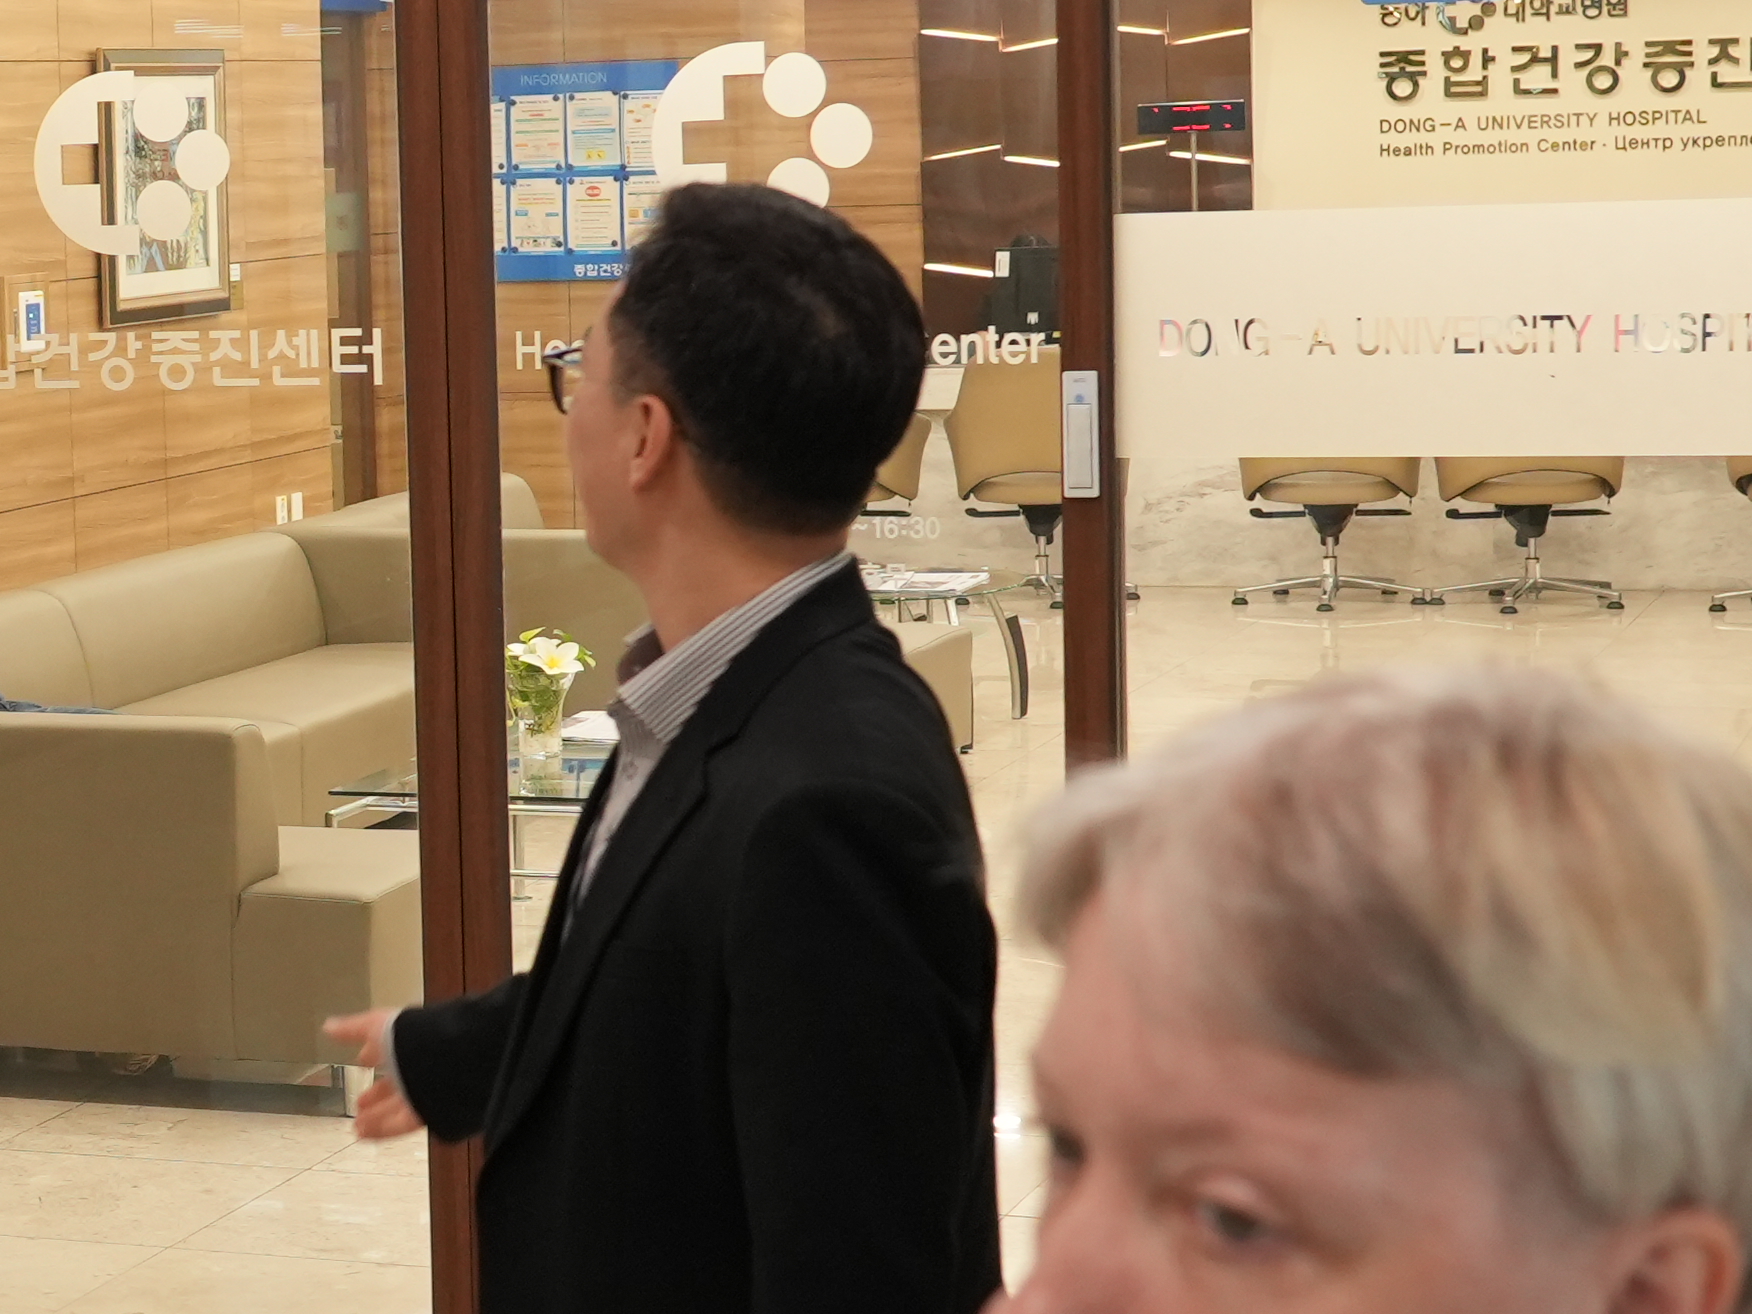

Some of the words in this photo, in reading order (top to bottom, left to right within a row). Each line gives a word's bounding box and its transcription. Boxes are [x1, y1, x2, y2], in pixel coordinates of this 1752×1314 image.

[520, 71, 607, 86] INFORMATION
[1477, 111, 1597, 131] UNIVERSITY
[1608, 109, 1707, 127] HOSPITAL
[1379, 141, 1435, 158] Health
[1442, 139, 1529, 155] Promotion
[1537, 137, 1596, 153] Center
[1615, 135, 1673, 151] Центр
[1355, 314, 1593, 356] UNIVERSITY
